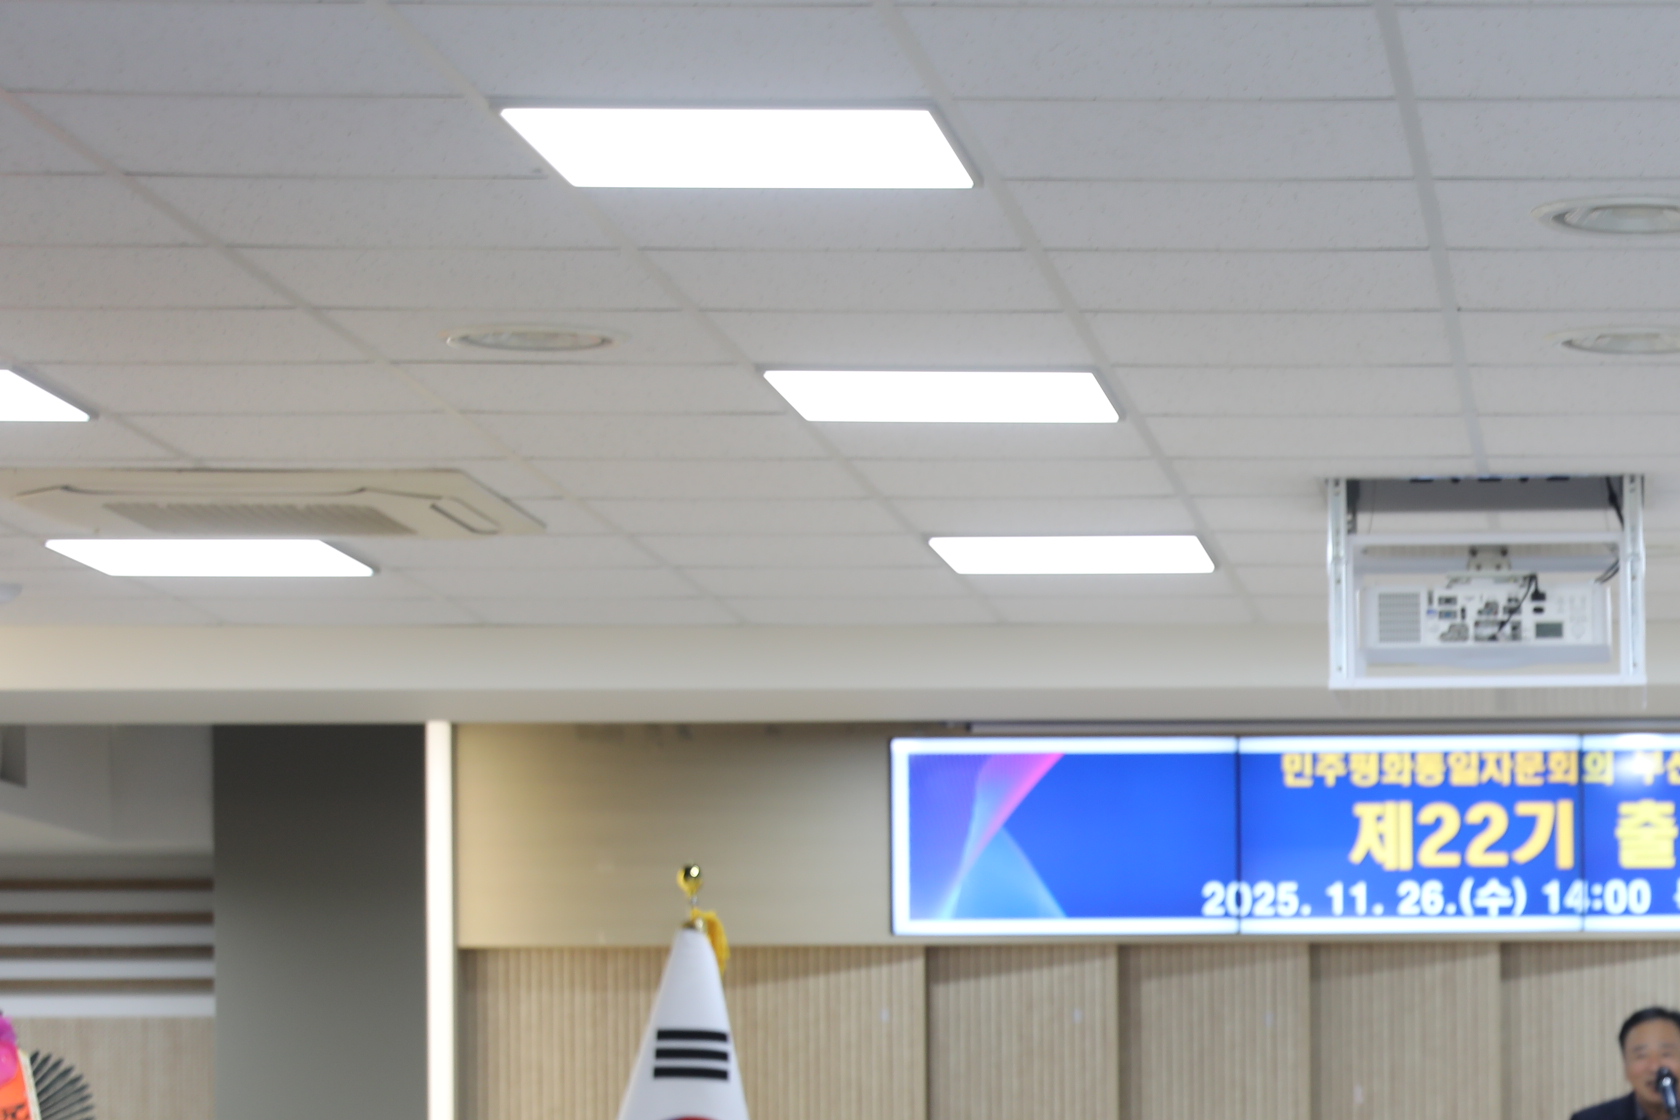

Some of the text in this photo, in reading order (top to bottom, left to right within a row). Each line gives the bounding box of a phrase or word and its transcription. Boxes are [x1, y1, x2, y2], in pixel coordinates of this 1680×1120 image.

[1281, 750, 1615, 788] 민주평화통일자문회의
[1348, 798, 1575, 871] 제22기
[1202, 880, 1312, 918] 2025.
[1325, 880, 1385, 917] 11.
[1396, 876, 1528, 918] 26.(수)
[1542, 877, 1652, 916] 14:00
